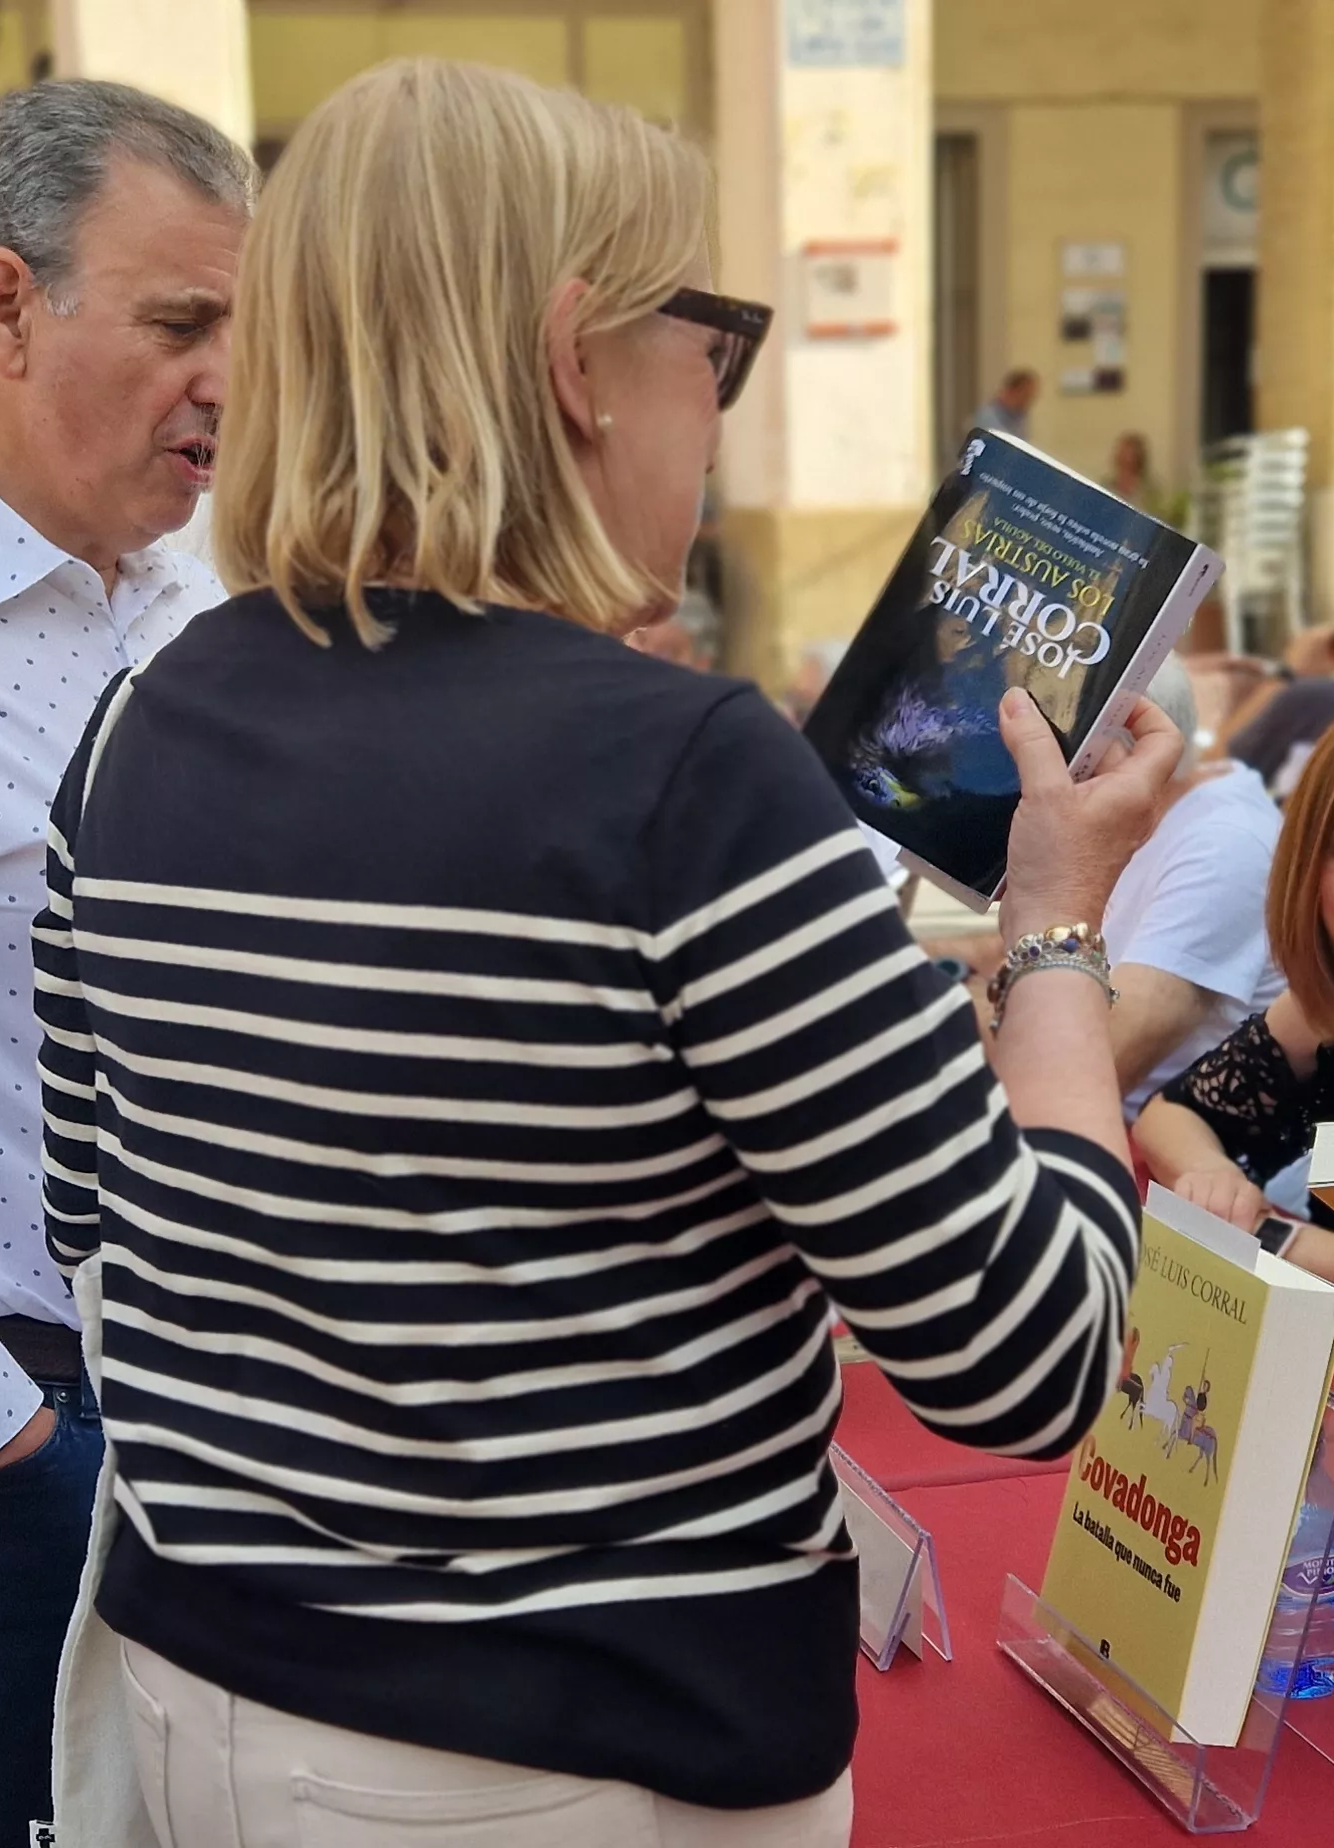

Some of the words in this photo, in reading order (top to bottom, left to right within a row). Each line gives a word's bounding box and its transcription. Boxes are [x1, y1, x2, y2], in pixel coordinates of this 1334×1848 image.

[959, 517, 1070, 589] AUSTRIAS
[1032, 538, 1053, 554] DEL
[1052, 549, 1086, 574] VUELO
[1085, 566, 1101, 580] EL
[927, 576, 1002, 637] LUIS
[928, 535, 1111, 666] CORRAL
[1065, 576, 1114, 616] LOS
[999, 619, 1082, 679] JOSÉ
[1161, 1256, 1190, 1290] LUIS
[1190, 1274, 1247, 1324] CORRAL
[1078, 1433, 1201, 1567] Covadonga
[1072, 1501, 1083, 1526] La
[1083, 1510, 1114, 1551] batalla
[1114, 1538, 1132, 1564] que
[1132, 1554, 1163, 1590] nunca
[1163, 1573, 1181, 1603] fue
